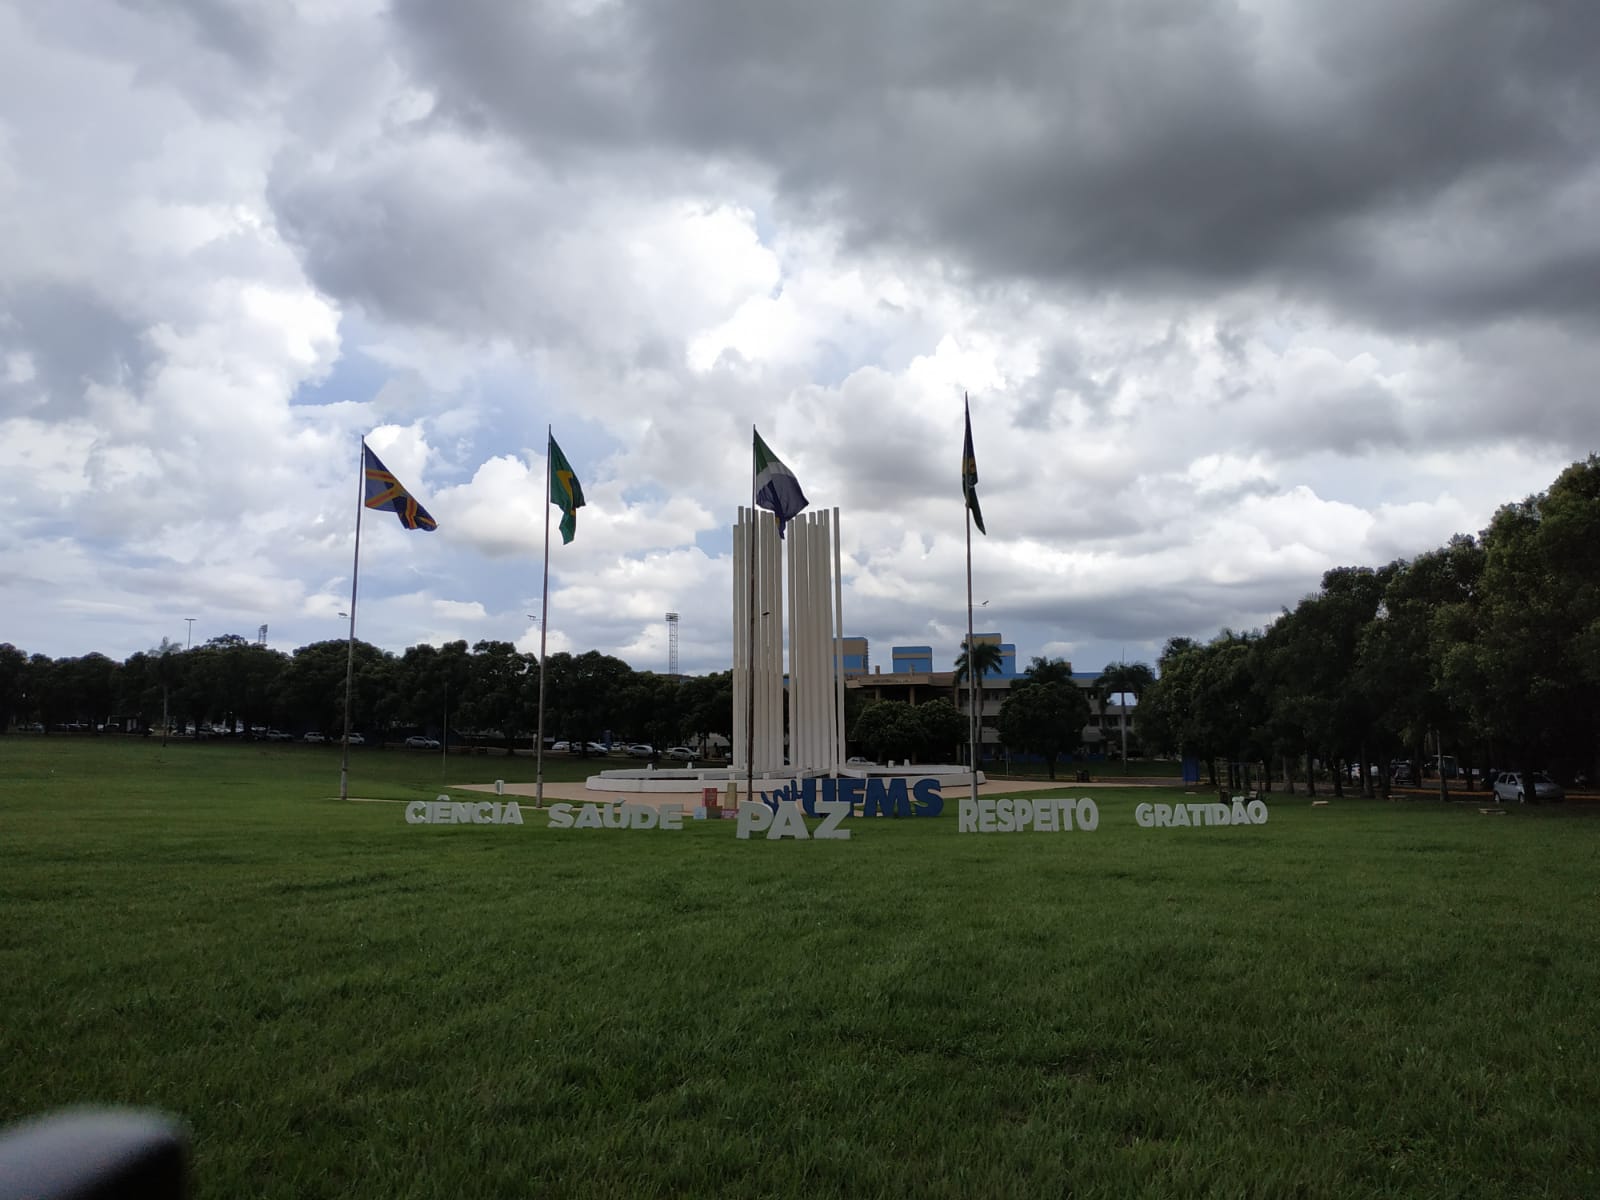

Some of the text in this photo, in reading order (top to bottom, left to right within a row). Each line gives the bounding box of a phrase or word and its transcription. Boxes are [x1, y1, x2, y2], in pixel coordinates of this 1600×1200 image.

[405, 795, 524, 825] CIÊNCIA
[802, 778, 945, 817] UFMS
[1135, 796, 1268, 828] GRATIDÃO
[547, 799, 684, 830] SAÚDE
[736, 801, 851, 840] PAZ
[958, 798, 1099, 832] RESPEITO
